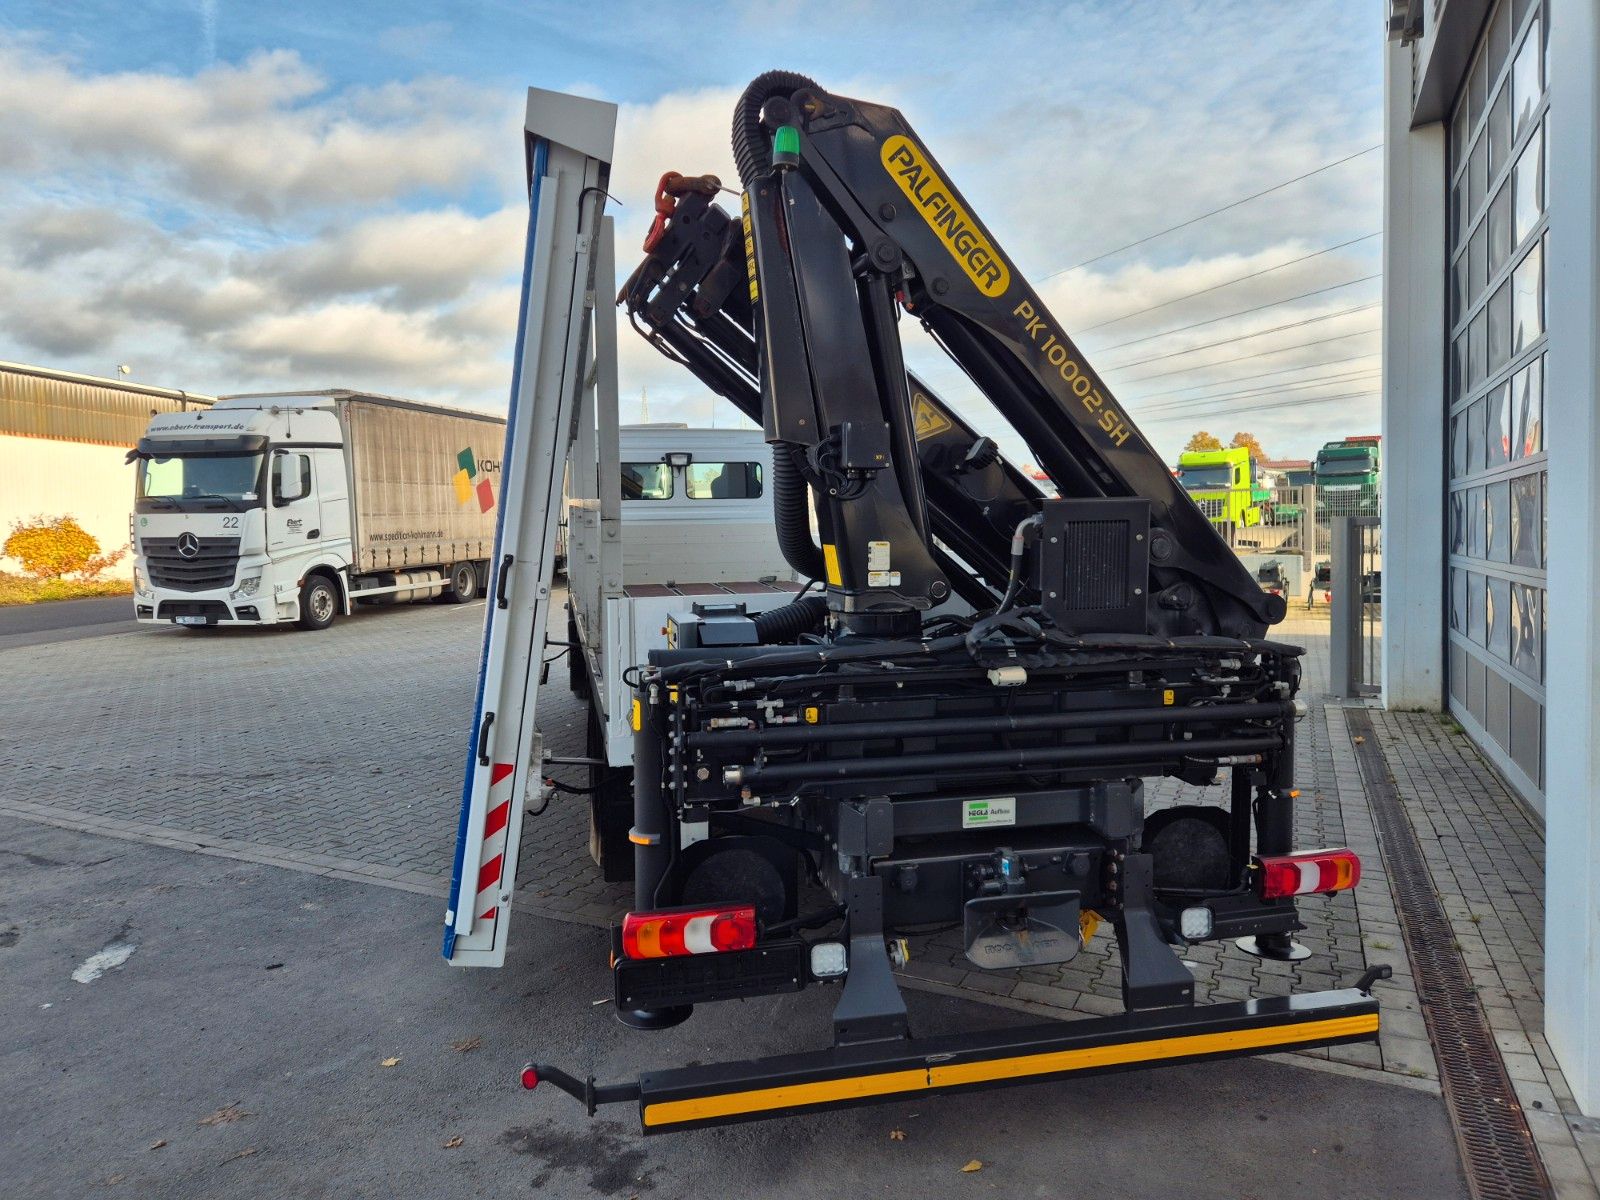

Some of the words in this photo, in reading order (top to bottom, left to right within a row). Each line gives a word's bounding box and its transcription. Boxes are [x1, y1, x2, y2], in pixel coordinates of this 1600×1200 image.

[887, 143, 1002, 290] PALFINGER
[1012, 300, 1047, 340] PK
[477, 459, 502, 473] KOH
[222, 516, 239, 529] 22
